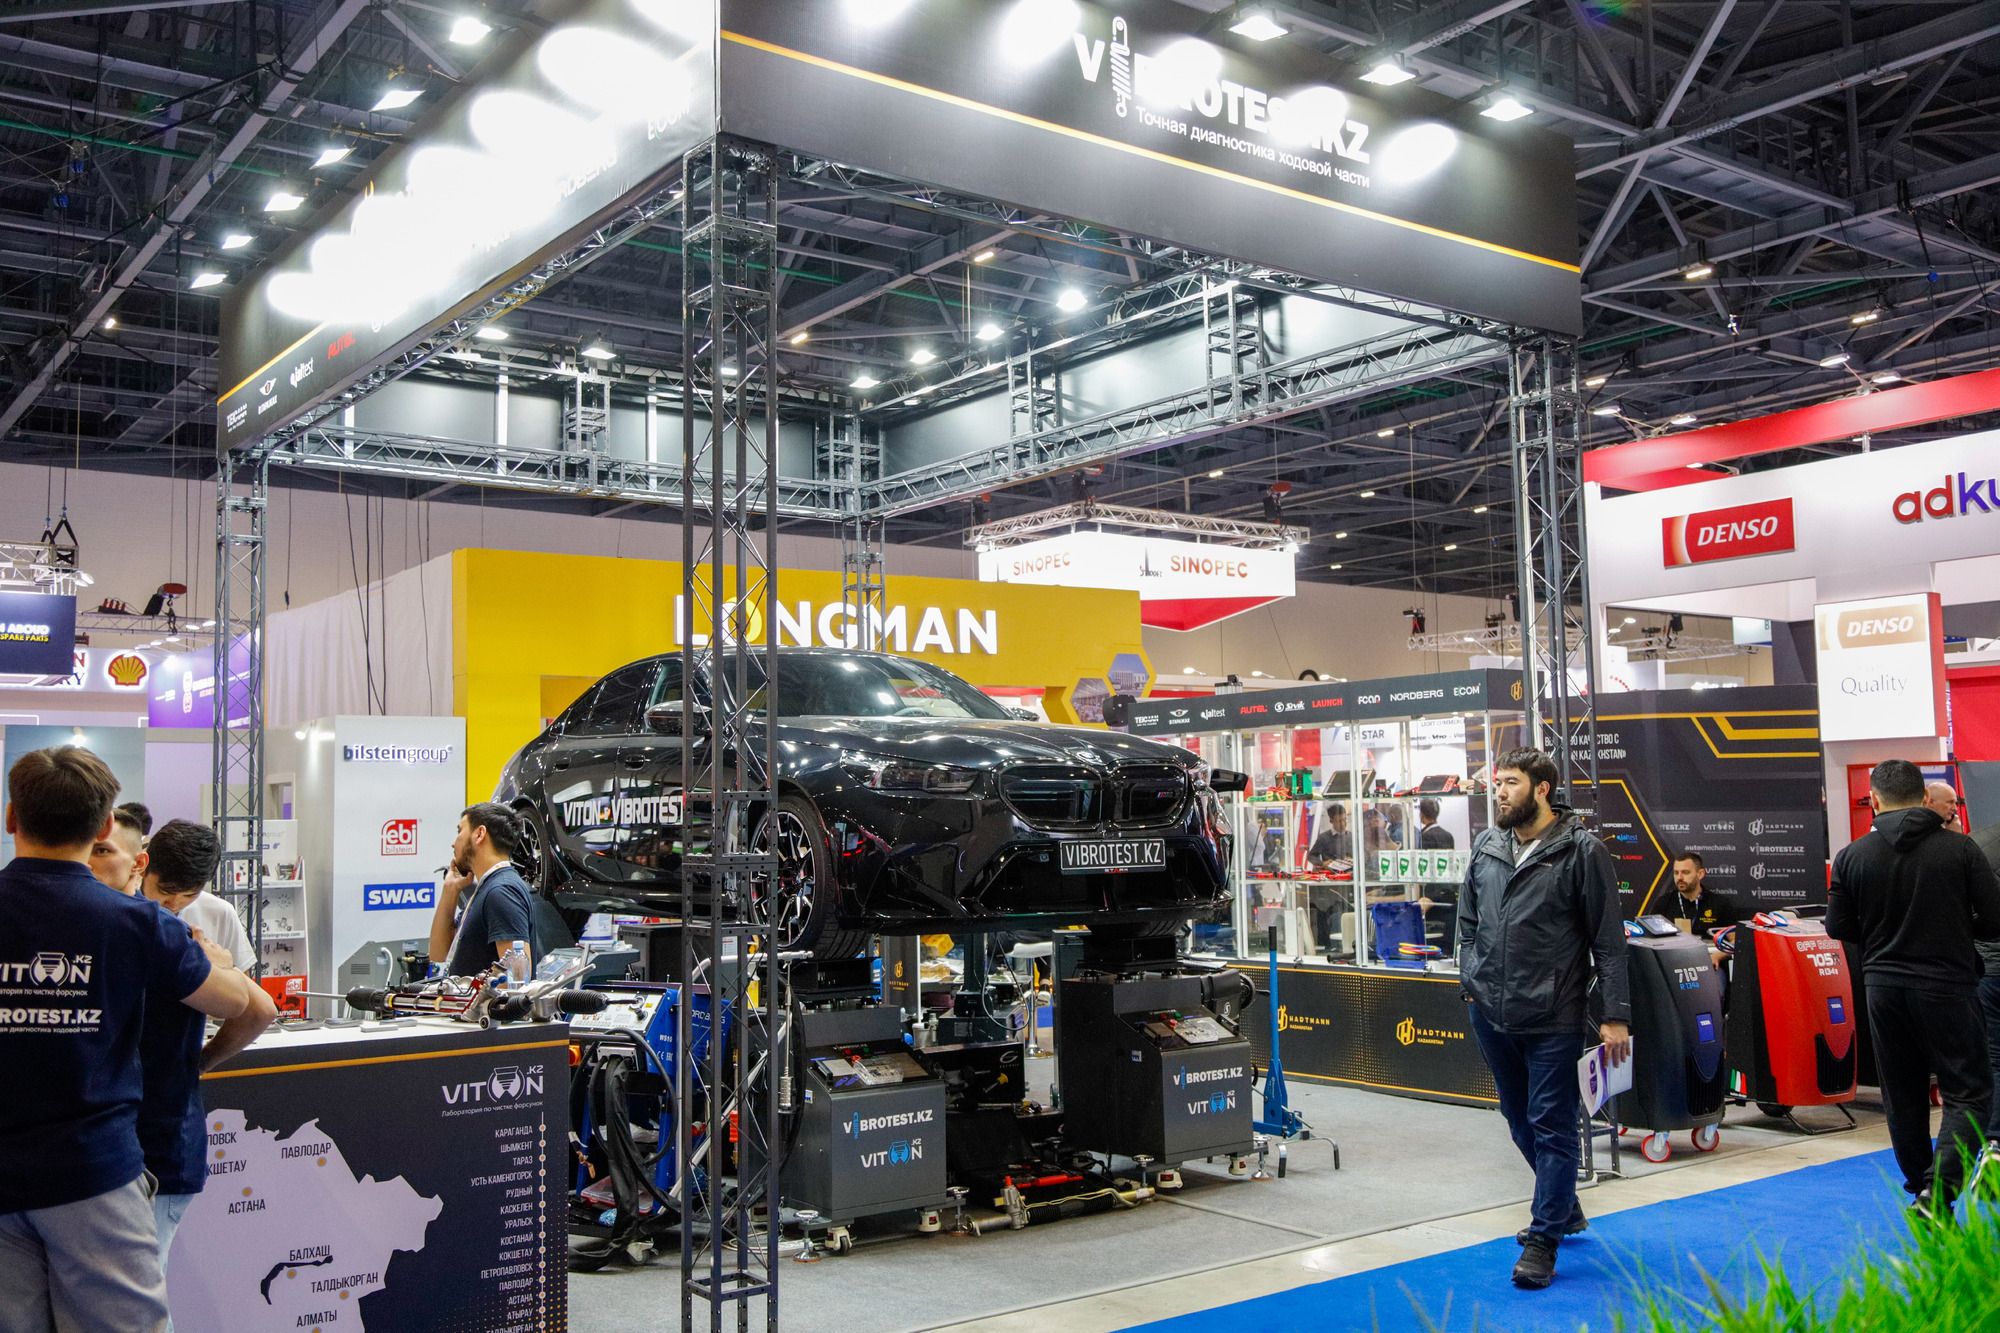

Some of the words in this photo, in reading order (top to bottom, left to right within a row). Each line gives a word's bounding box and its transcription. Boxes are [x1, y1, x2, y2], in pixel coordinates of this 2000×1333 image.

[1135, 106, 1187, 136] Точная
[1190, 126, 1275, 161] диагностика
[1278, 151, 1332, 177] ходовой
[1334, 168, 1370, 188] части
[1697, 516, 1778, 547] DENSO
[1013, 552, 1071, 576] SINOPEC
[1170, 554, 1249, 578] SINOPEC
[674, 595, 998, 655] LONGMAN
[1846, 616, 1914, 638] DENSO
[1841, 674, 1908, 696] Quality
[1390, 689, 1444, 702] NORDBERG
[1361, 730, 1385, 740] STAR
[343, 745, 448, 763] bilsteingroup
[563, 800, 601, 826] VITON
[381, 821, 417, 844] febi
[1066, 842, 1162, 866] VIBROTEST.KZ
[368, 888, 432, 905] SWAG
[441, 1106, 483, 1118] Лаборатория
[483, 1105, 492, 1113] по
[493, 1103, 513, 1112] чистке
[513, 1101, 544, 1110] форсунок
[495, 1125, 533, 1138] КАРАГАНДА
[281, 1142, 332, 1159] ПАВЛОДАР
[500, 1141, 533, 1153] ШЫМКЕНТ
[512, 1155, 533, 1166] ТАРАЗ
[470, 1177, 487, 1187] УСТЬ
[488, 1171, 533, 1185] КАМЕНОГОРСК
[506, 1185, 533, 1198] РУДНЫЙ
[228, 1199, 266, 1215] АСТАНА
[500, 1202, 533, 1215] КАСКЕЛЕН
[504, 1217, 533, 1229] УРАЛЬСК
[500, 1232, 534, 1246] КОСТАНАЙ
[289, 1245, 331, 1262] БАЛХАШ
[499, 1248, 534, 1261] КОКШЕТАУ
[481, 1262, 533, 1279] ПЕТРОПАВЛОВСК
[311, 1272, 379, 1293] ТАЛДЫКОРГАН
[499, 1277, 533, 1291] ПАВЛОДАР
[508, 1293, 533, 1305] АСТАНА
[296, 1310, 338, 1328] АЛМАТЫ
[507, 1308, 533, 1320] АТЫРАУ
